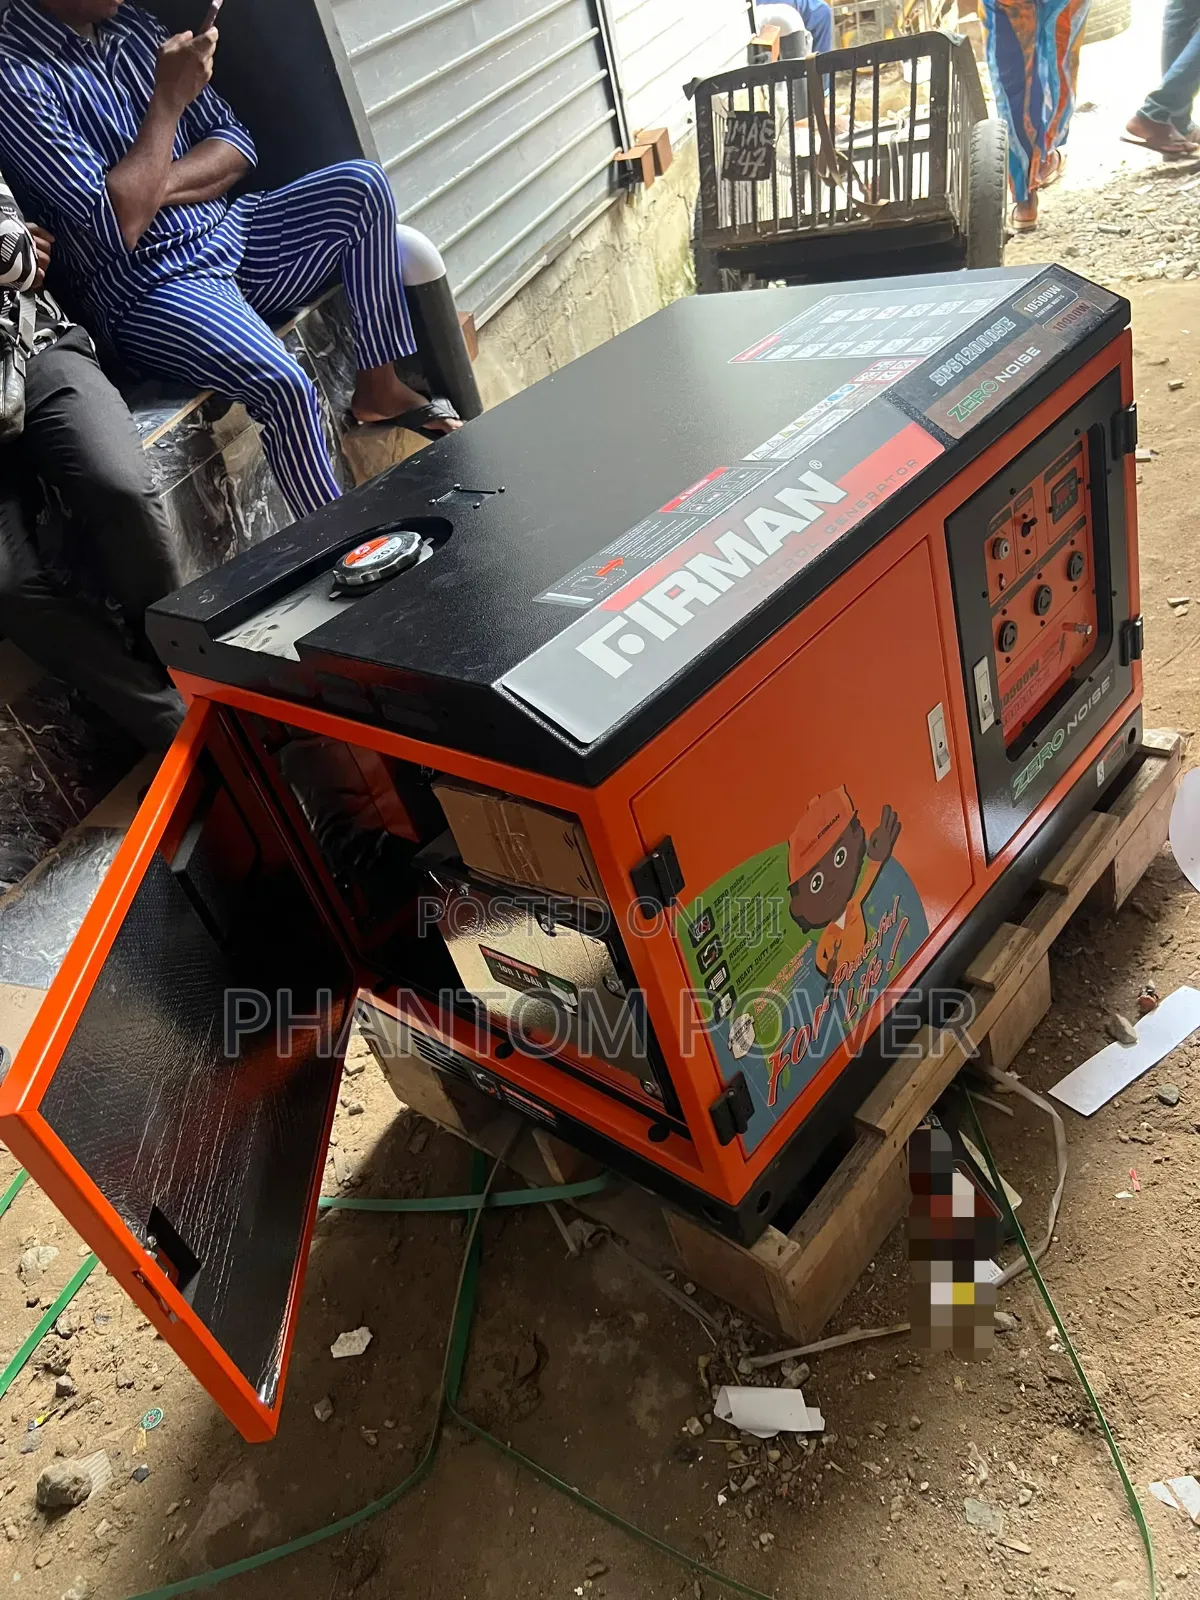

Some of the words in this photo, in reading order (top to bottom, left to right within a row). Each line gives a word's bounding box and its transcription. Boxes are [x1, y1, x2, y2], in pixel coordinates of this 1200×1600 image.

[1023, 284, 1062, 314] 10500W
[1052, 302, 1091, 333] 10000W
[929, 316, 1016, 387] SPS12000SE
[947, 380, 999, 423] ZERO
[995, 345, 1042, 384] NOISE
[824, 458, 918, 535] GENERATOR
[575, 470, 848, 679] FIRMAN
[1013, 728, 1065, 800] ZERO
[1067, 676, 1110, 735] NOISE
[713, 888, 730, 909] ZERO
[729, 873, 746, 893] noise
[767, 995, 830, 1107] For
[832, 895, 900, 1001] Peaceful
